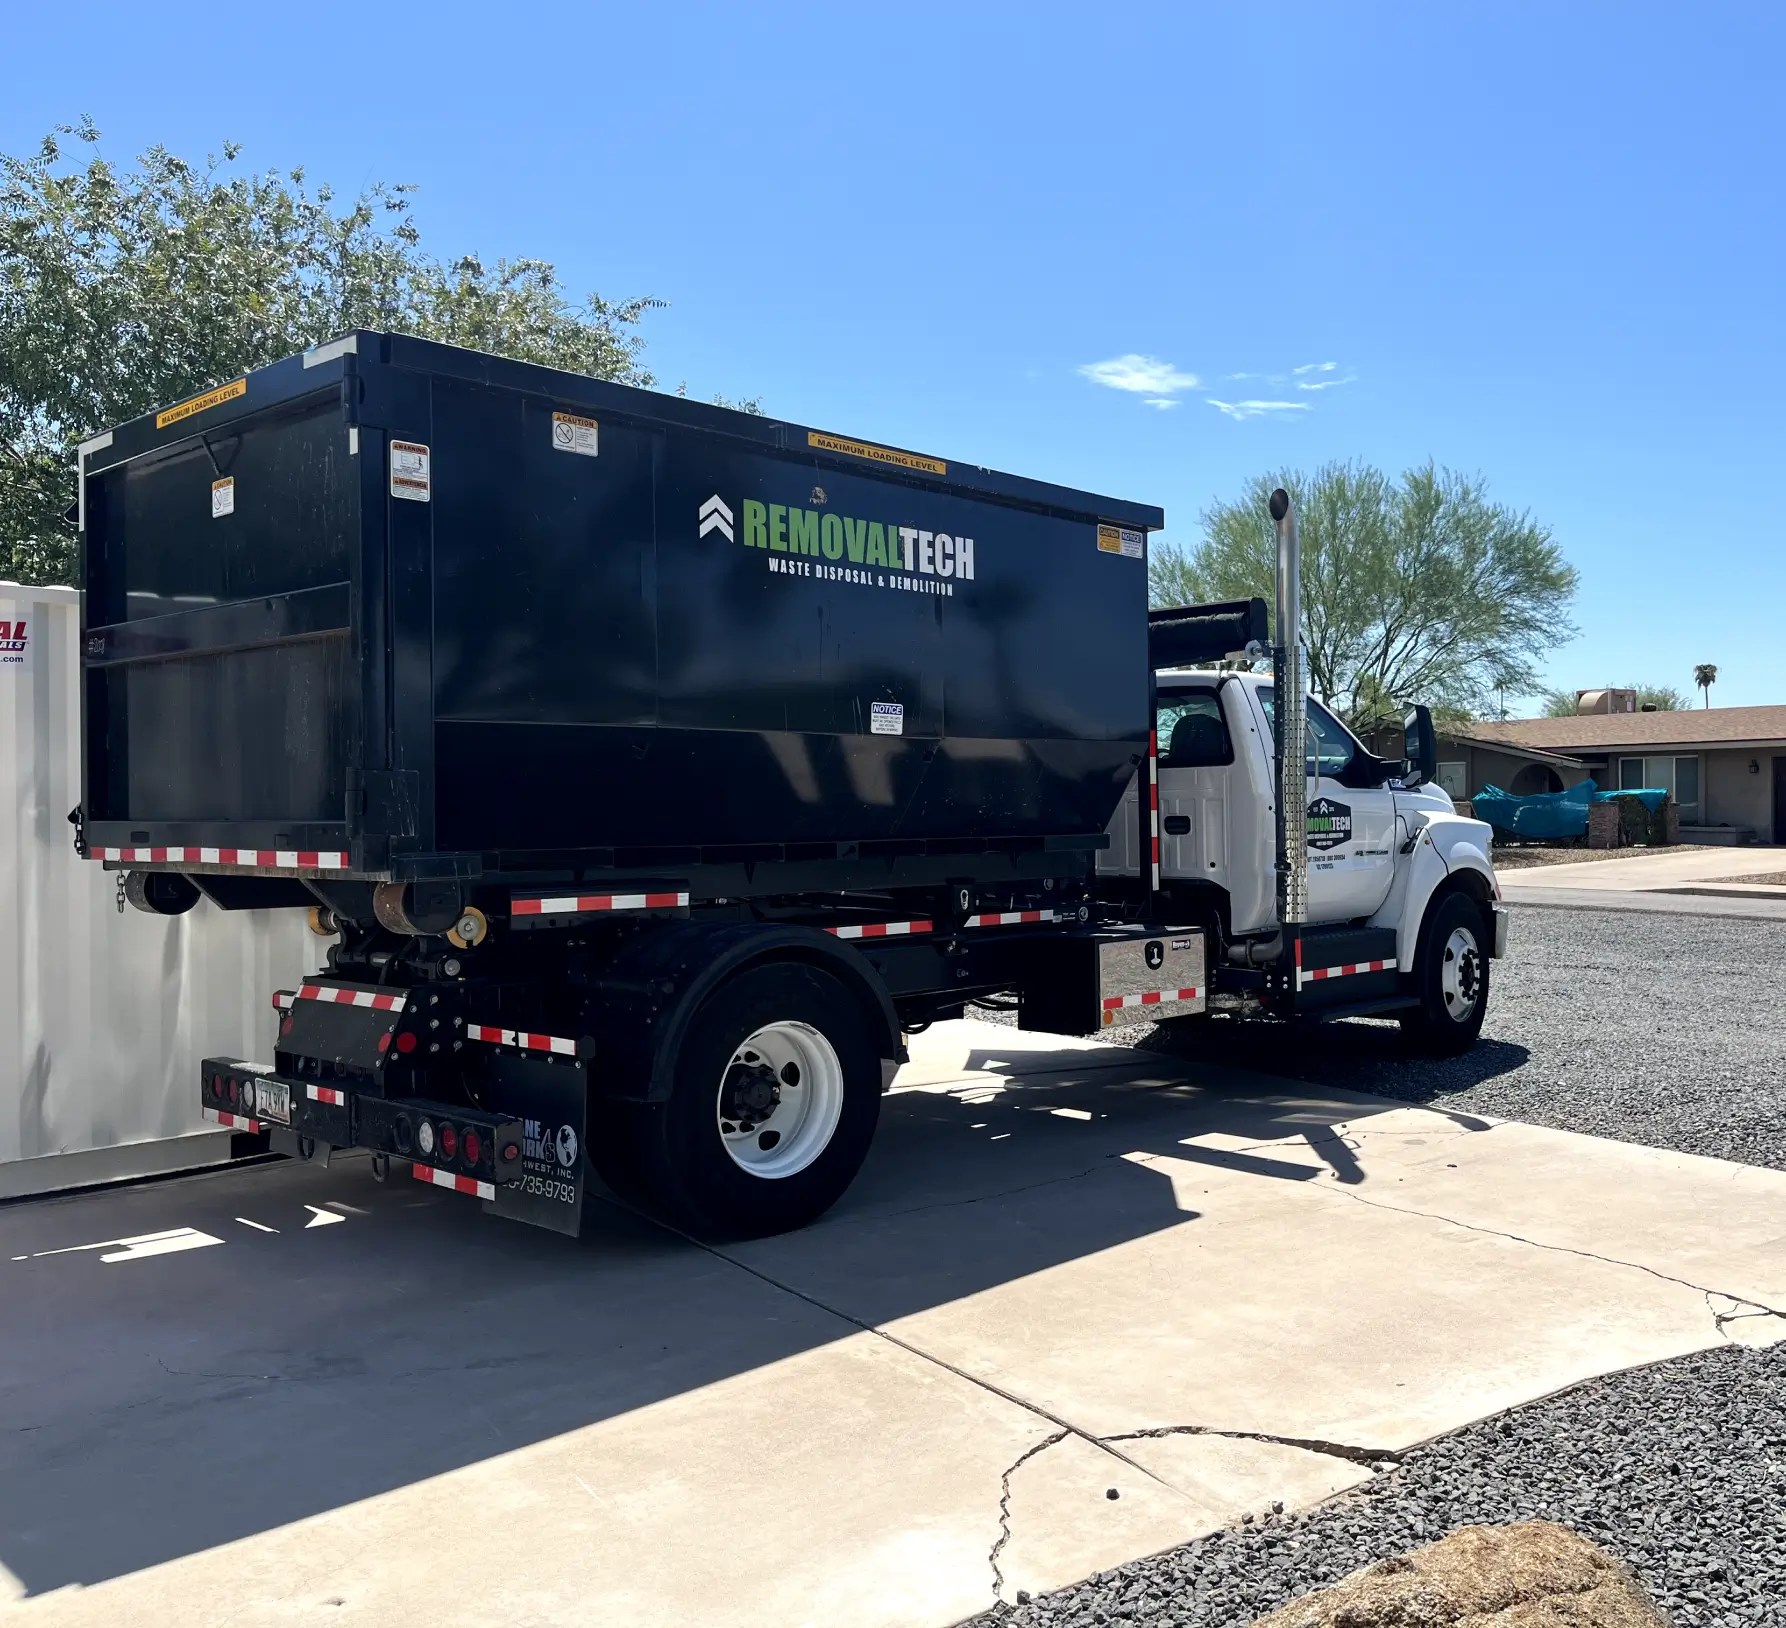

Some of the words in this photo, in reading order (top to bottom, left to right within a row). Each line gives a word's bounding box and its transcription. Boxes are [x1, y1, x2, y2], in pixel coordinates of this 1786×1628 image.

[161, 406, 190, 424] MAXIMUM
[191, 395, 219, 413] LOADING
[219, 387, 240, 401] LEVEL
[562, 415, 594, 428] CAUTION
[399, 444, 427, 454] WARNING
[817, 438, 865, 456] MAXIMUM
[867, 449, 908, 465] LOADING
[910, 457, 938, 472] LEVEL
[742, 498, 975, 581] REMOVALTECH
[1099, 527, 1119, 539] CAUTION
[1122, 531, 1141, 543] NOTICE
[768, 557, 811, 577] WASTE
[815, 564, 873, 586] DISPOSAL
[878, 575, 885, 587] &
[889, 575, 953, 597] DEMOLITION
[0, 621, 28, 640] AL
[0, 641, 23, 649] ALS
[873, 704, 902, 715] NOTICE
[1306, 816, 1351, 832] MOVALTECH
[523, 1118, 541, 1140] NE
[557, 1168, 575, 1180] INC.
